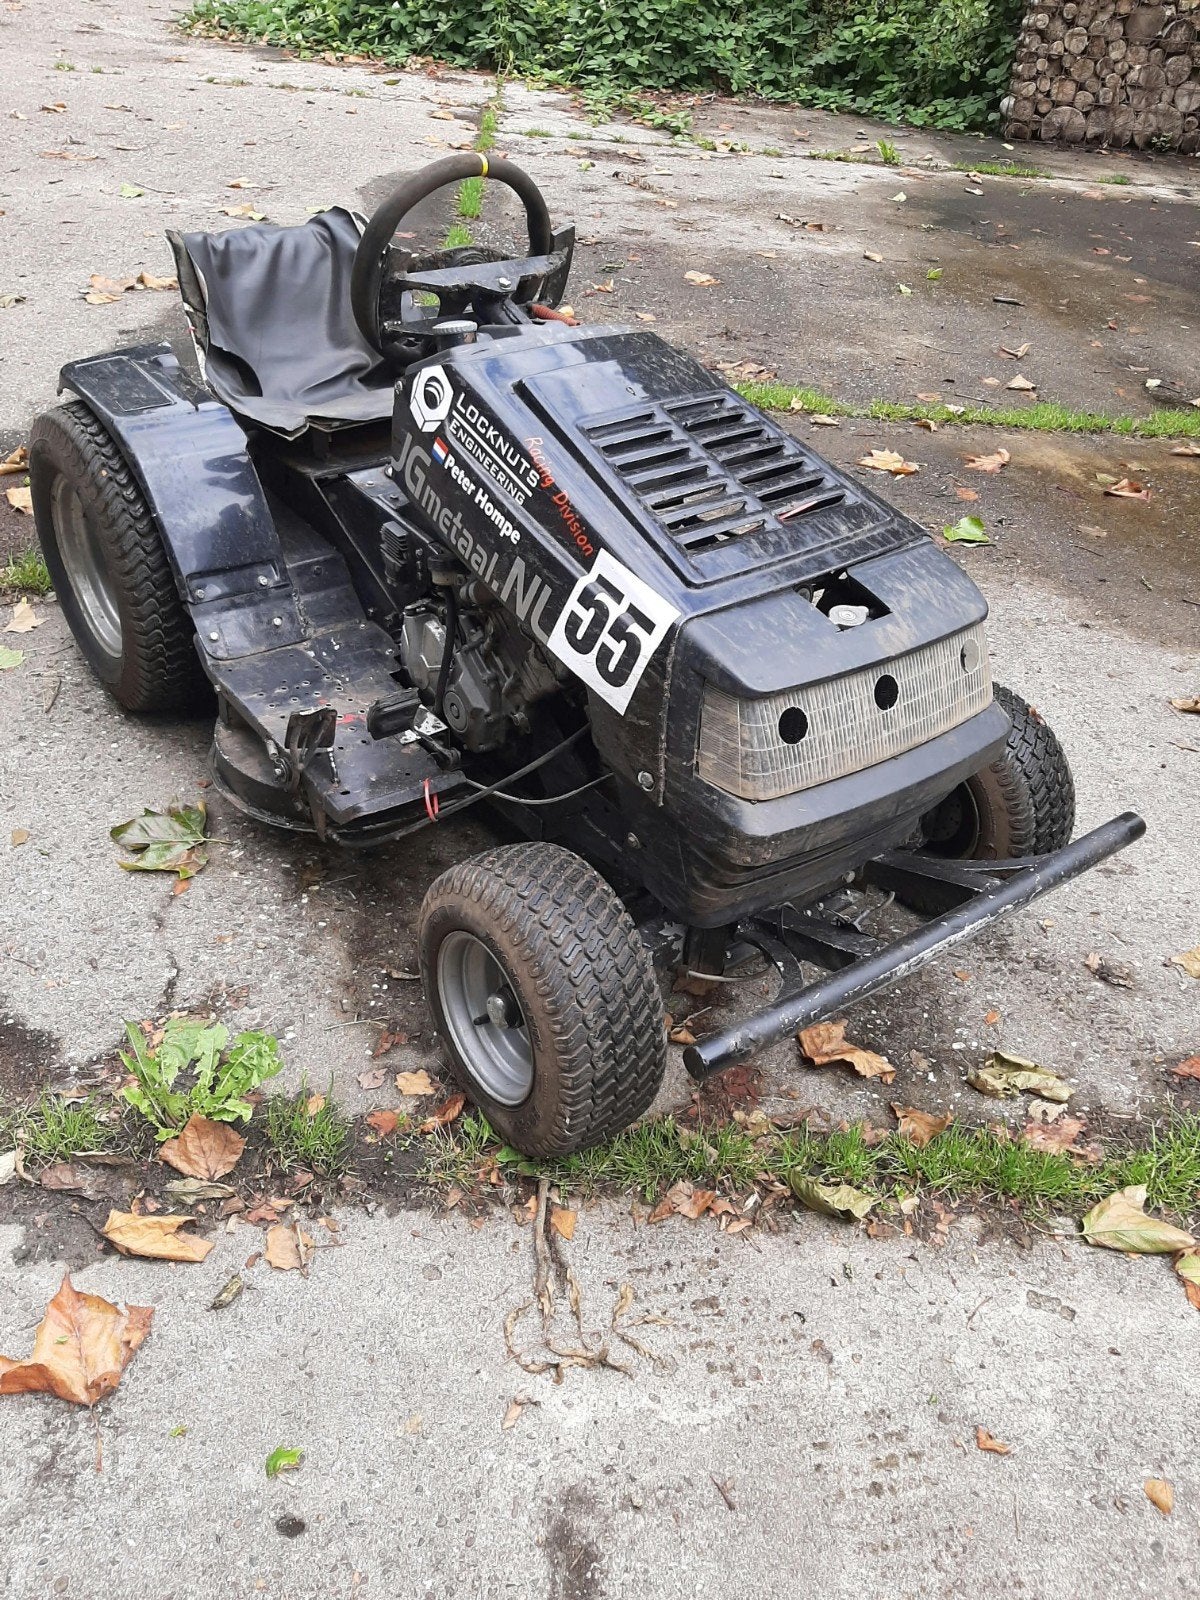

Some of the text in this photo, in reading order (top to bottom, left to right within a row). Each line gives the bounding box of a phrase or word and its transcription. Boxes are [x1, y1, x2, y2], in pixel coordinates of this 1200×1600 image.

[449, 420, 526, 506] ENGINEERING
[456, 391, 541, 488] LOCKNUTS
[444, 456, 521, 545] Peter Hompe
[523, 436, 595, 557] Racing Division
[564, 573, 657, 689] 55
